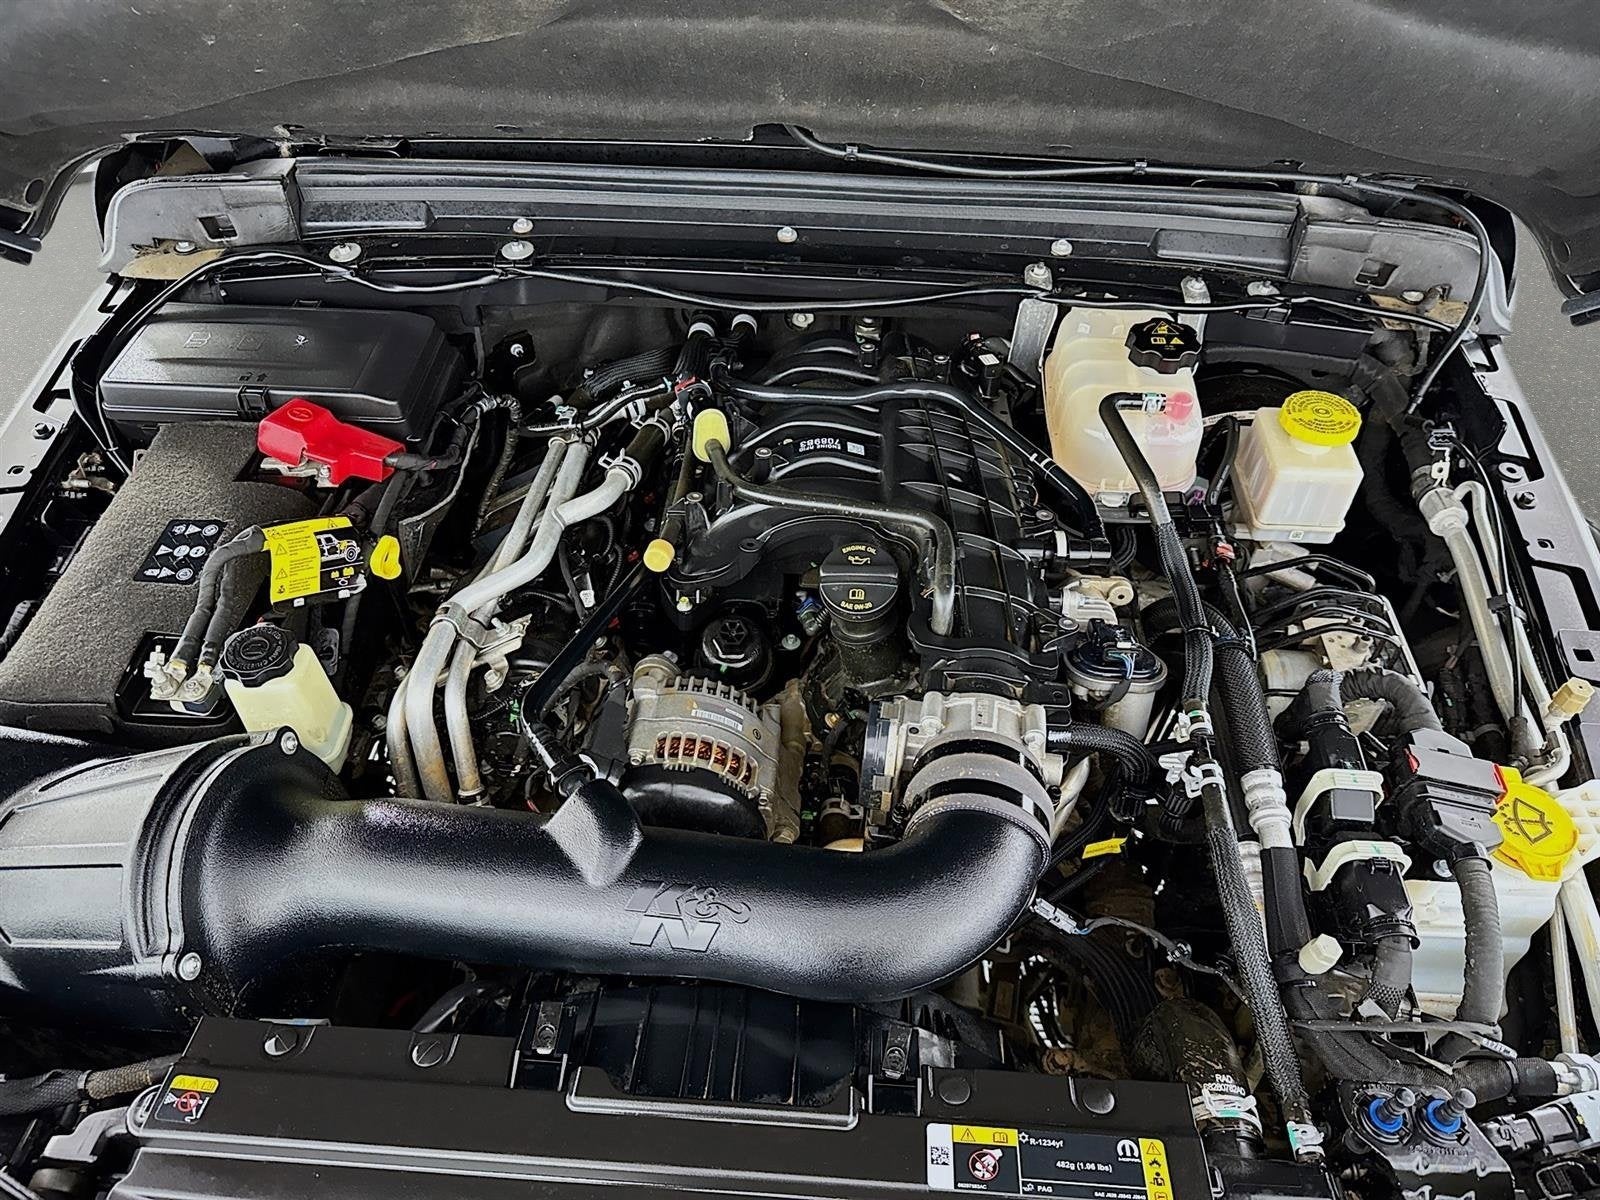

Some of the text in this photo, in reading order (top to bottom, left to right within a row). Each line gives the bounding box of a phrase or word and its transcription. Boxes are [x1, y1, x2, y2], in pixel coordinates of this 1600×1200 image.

[841, 544, 877, 555] ENGINE OIL
[840, 600, 873, 610] SAE 0W-20
[1215, 1073, 1234, 1084] RAD
[1029, 1138, 1064, 1149] R-1234yf
[1056, 1160, 1075, 1170] 482g
[1097, 1163, 1113, 1173] lbs)
[1037, 1185, 1053, 1193] PAG
